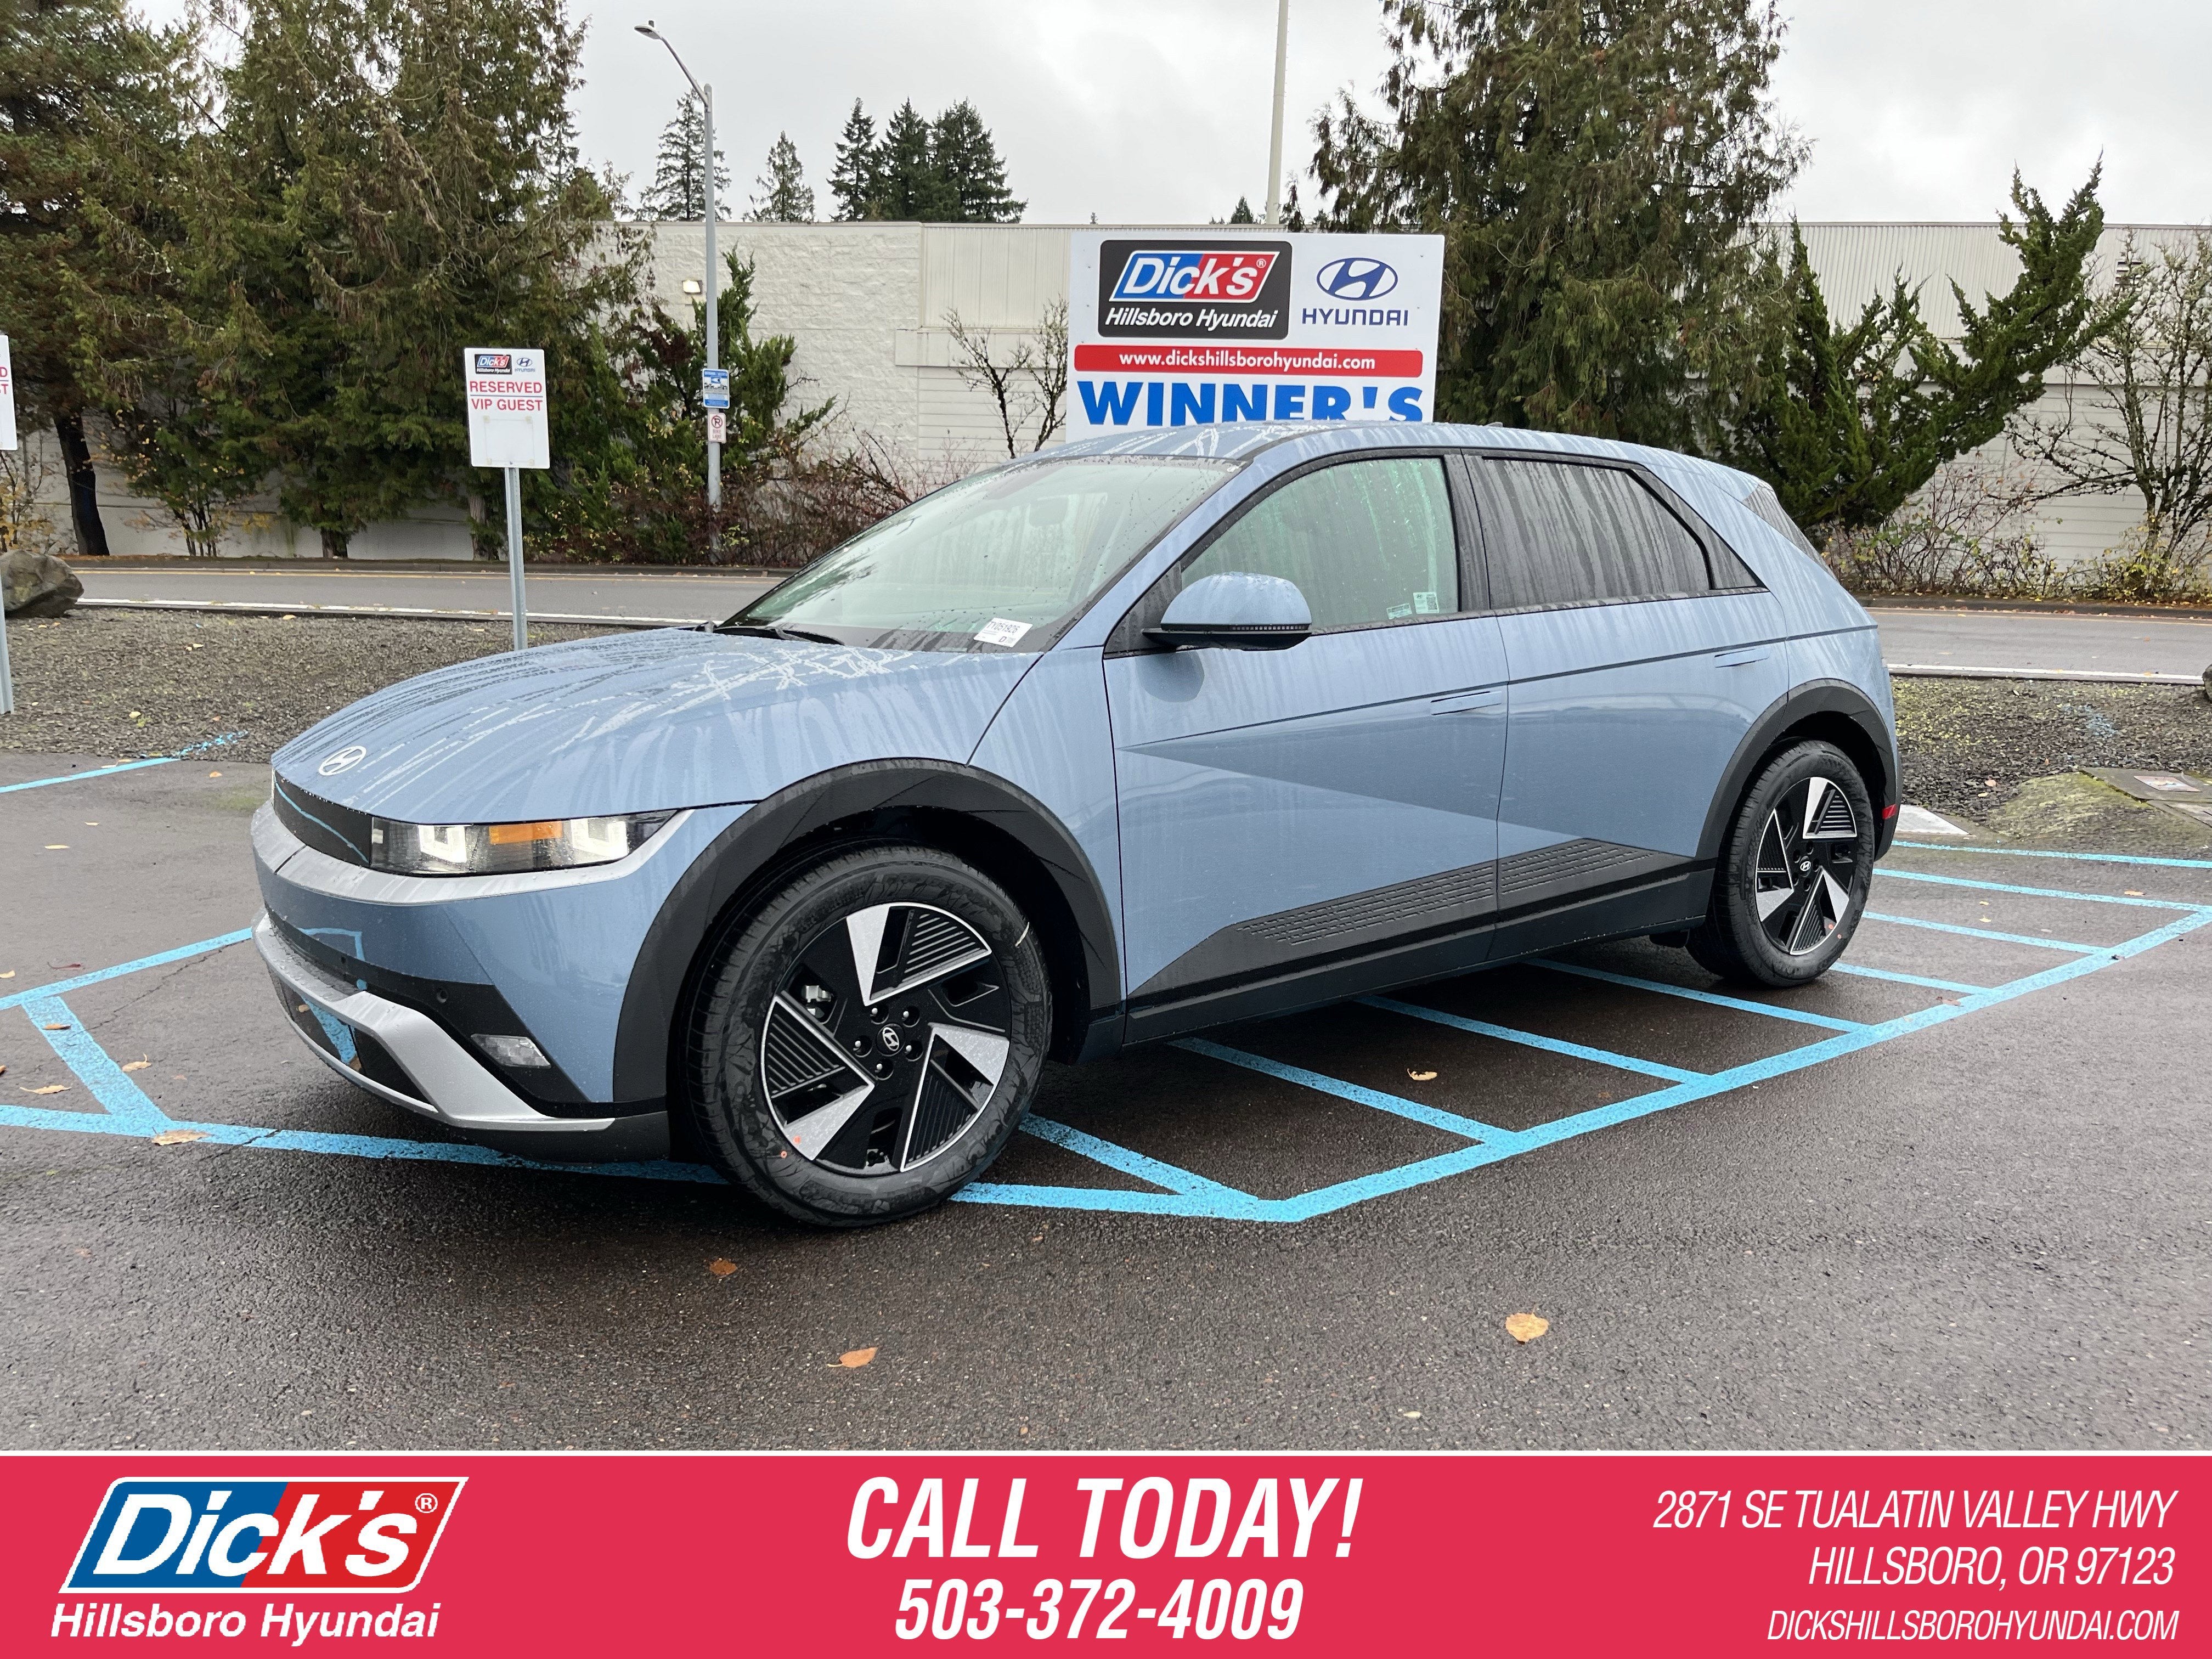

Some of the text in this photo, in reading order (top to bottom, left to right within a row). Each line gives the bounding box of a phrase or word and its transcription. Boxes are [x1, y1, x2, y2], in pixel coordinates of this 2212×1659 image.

[1122, 256, 1259, 296] Dick's
[1105, 307, 1279, 331] Hillsboro Hyundai
[1302, 308, 1408, 326] HYUNDAI
[1119, 349, 1376, 371] www.dickshillsborohyundai.com
[470, 381, 543, 393] RESERVED
[471, 399, 543, 411] VIP GUEST
[1077, 381, 1423, 427] WINNER'S
